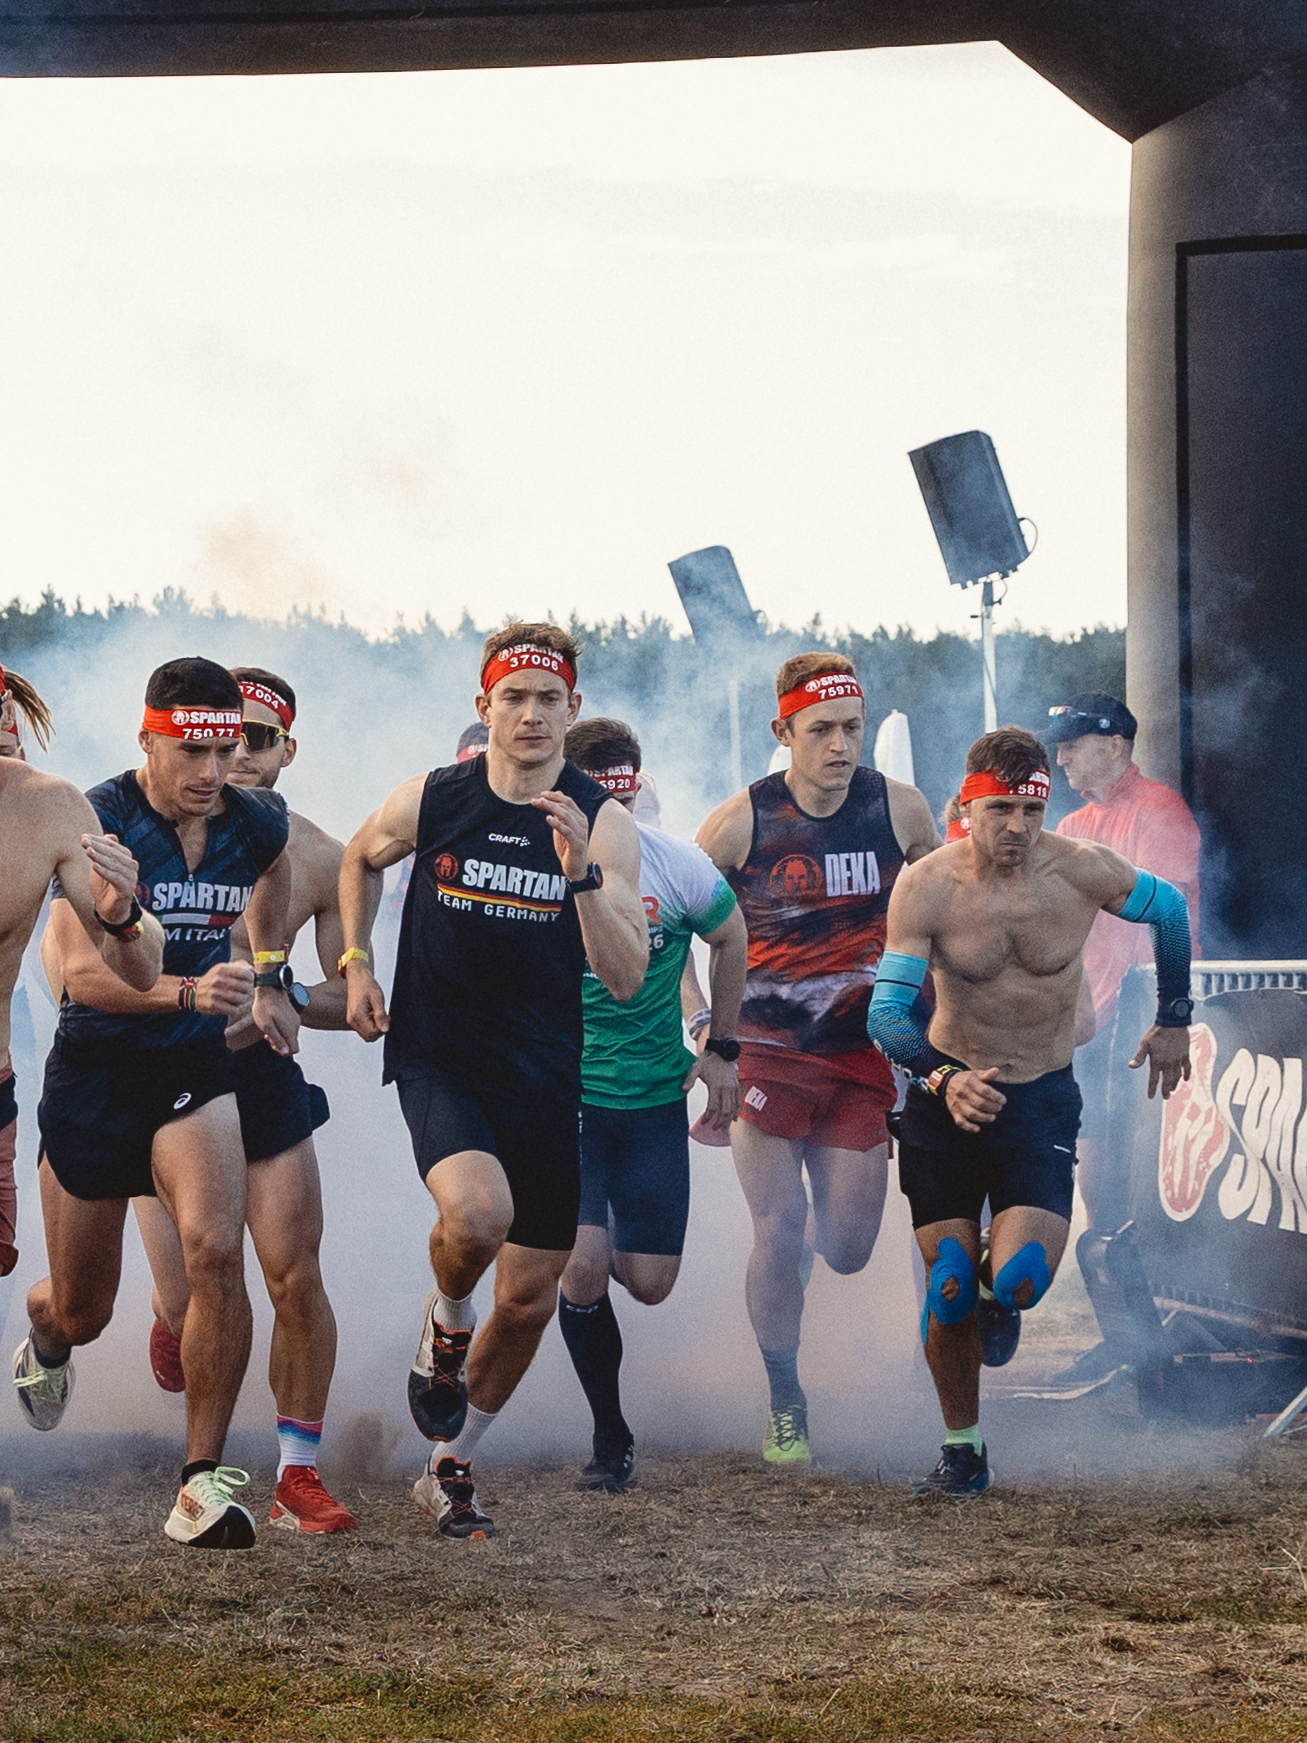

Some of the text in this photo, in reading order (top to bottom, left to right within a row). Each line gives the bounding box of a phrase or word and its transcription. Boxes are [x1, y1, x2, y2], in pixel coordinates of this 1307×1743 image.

[510, 654, 559, 671] 37006
[818, 685, 858, 699] 75971
[182, 728, 234, 740] 75077
[599, 779, 631, 789] 5920
[1009, 784, 1047, 797] 5819
[488, 833, 522, 845] CRAFT
[462, 859, 567, 901] SPARTAN
[824, 851, 881, 897] DEKA
[152, 882, 254, 912] SPARTAN
[437, 890, 560, 923] TEAM GERMANY
